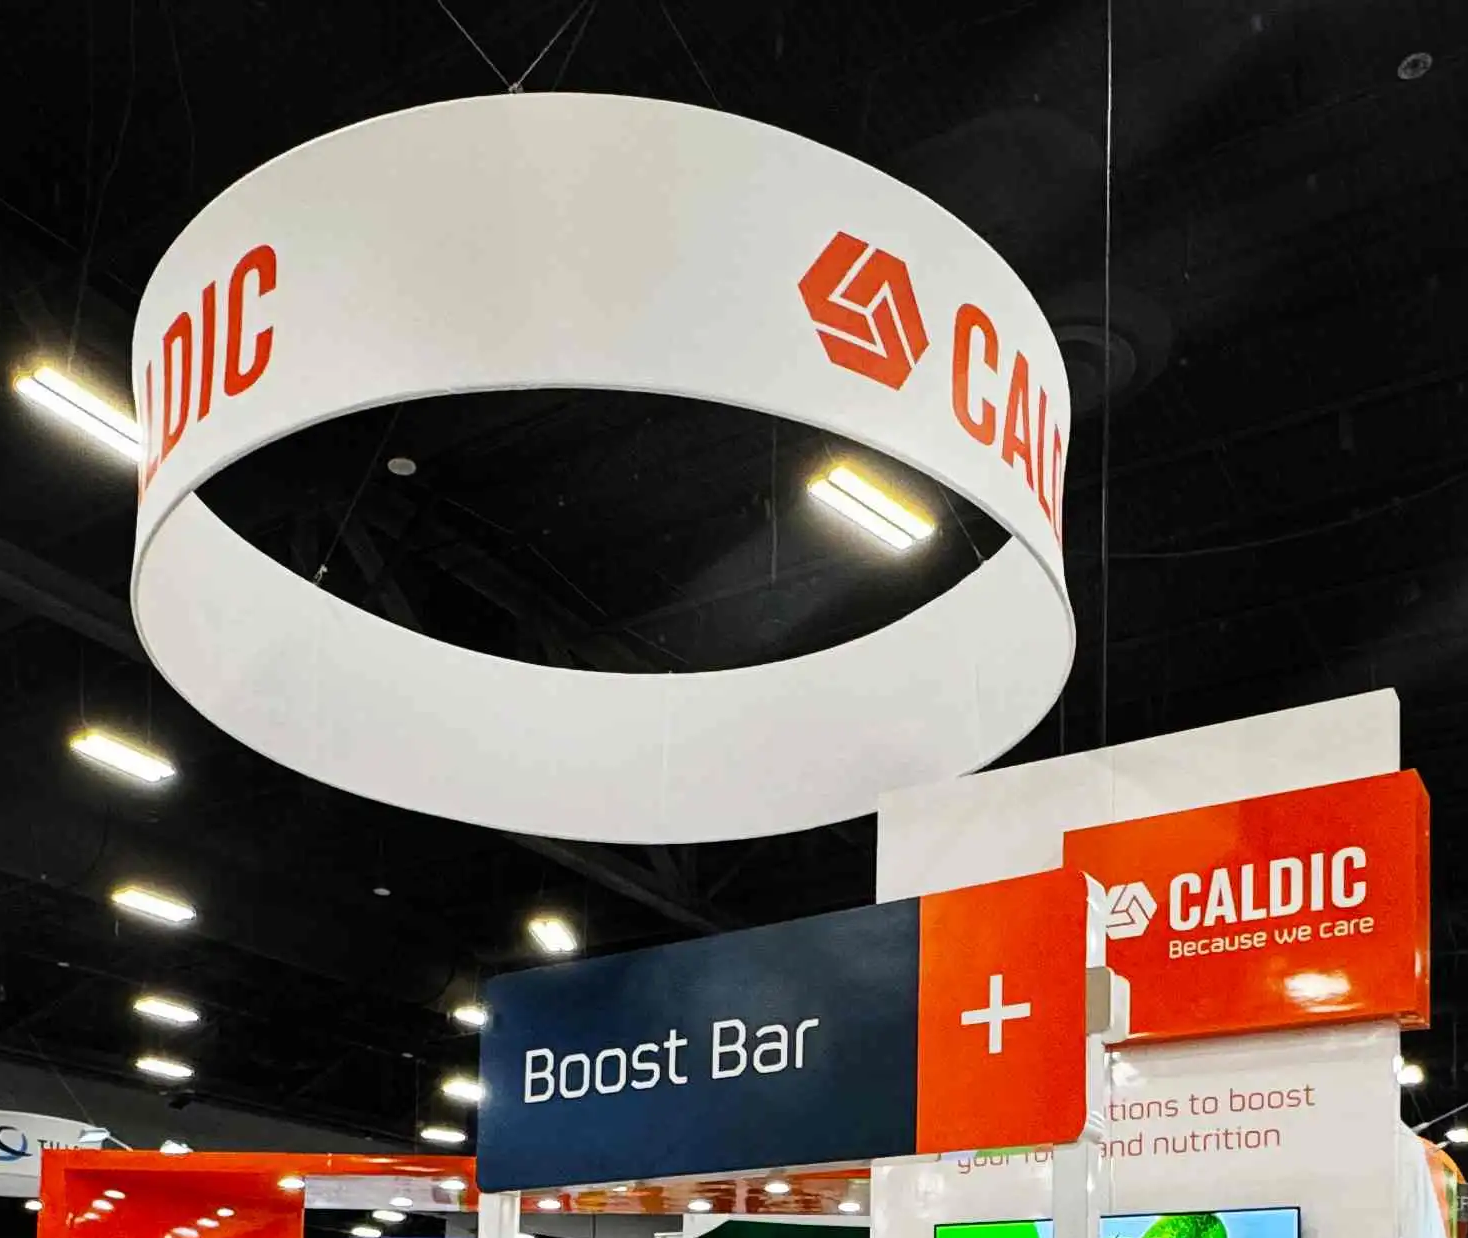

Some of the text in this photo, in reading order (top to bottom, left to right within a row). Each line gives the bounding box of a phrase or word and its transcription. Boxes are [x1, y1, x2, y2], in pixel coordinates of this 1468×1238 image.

[138, 244, 277, 505] LDIC
[951, 303, 1063, 550] CALD
[1169, 846, 1367, 932] CALDIC
[1169, 915, 1375, 960] Because we care
[523, 1029, 688, 1104] Boost
[711, 1017, 819, 1080] Bar
[1104, 1083, 1316, 1122] tions to boost
[1153, 1126, 1281, 1156] nutrition
